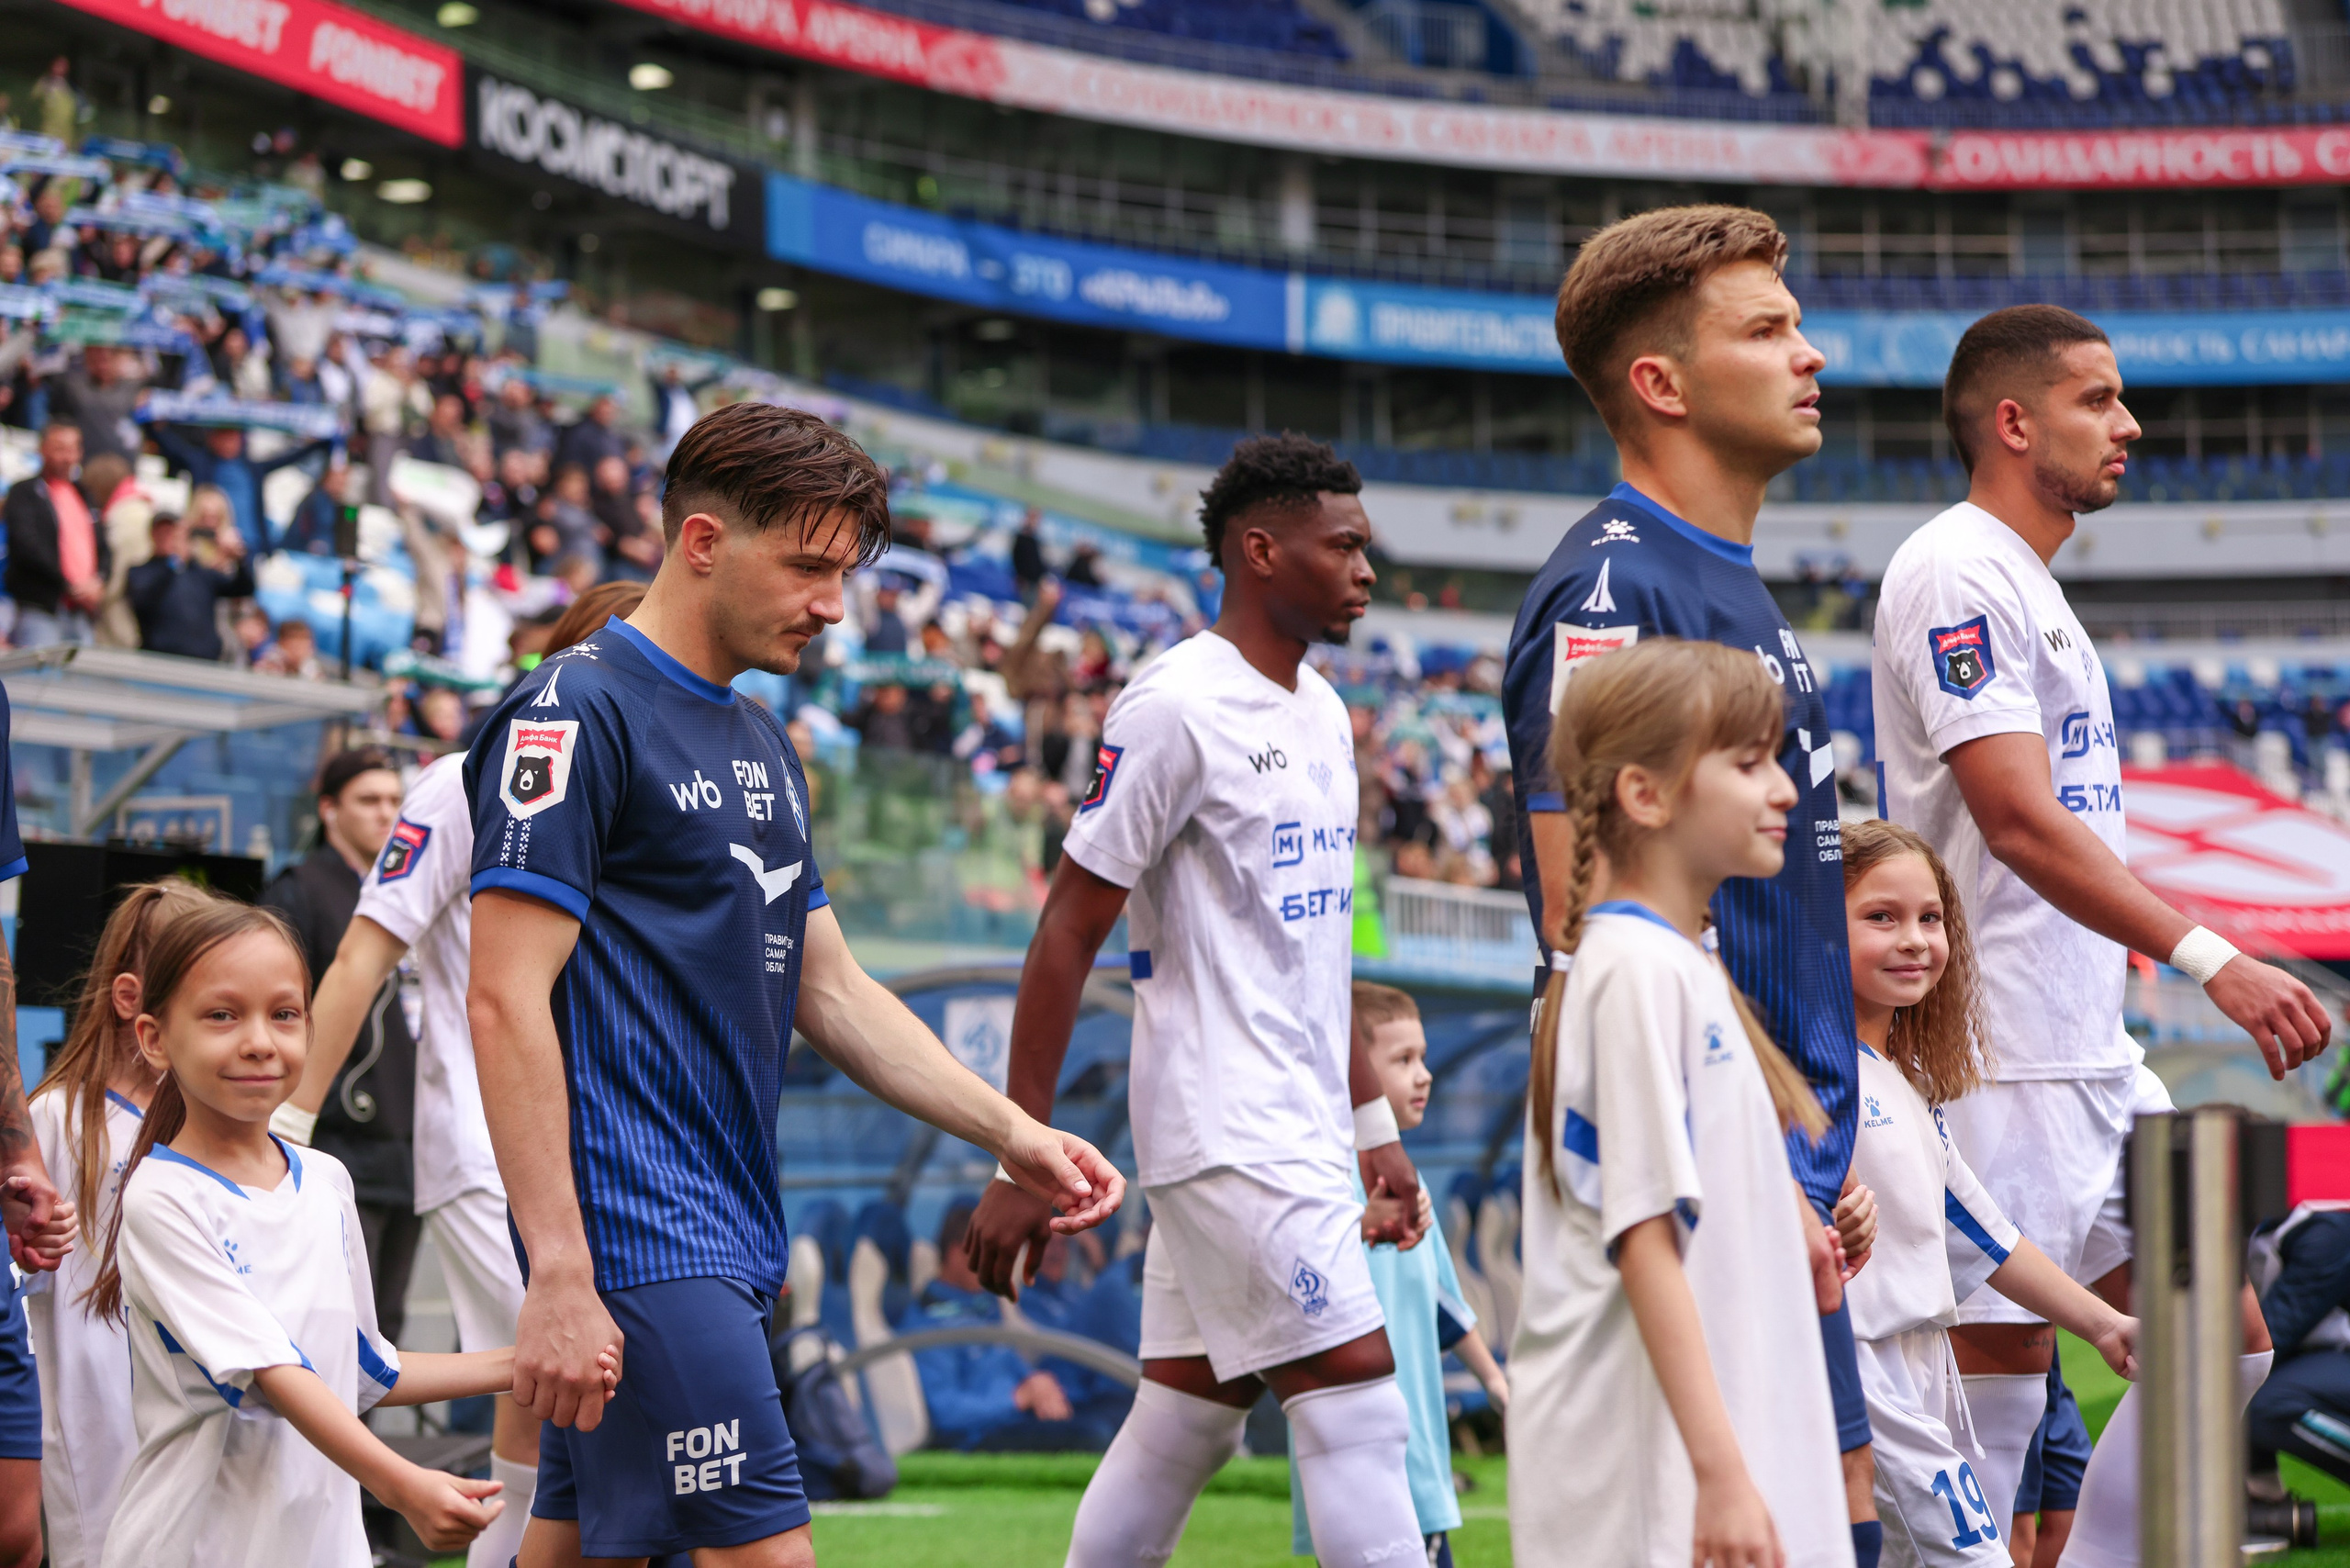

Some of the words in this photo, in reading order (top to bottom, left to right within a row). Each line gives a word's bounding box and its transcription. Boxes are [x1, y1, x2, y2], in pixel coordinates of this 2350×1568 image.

[140, 0, 291, 54] NBET
[732, 760, 769, 789] FON
[1248, 742, 1287, 774] wb
[669, 769, 722, 812] wb
[744, 790, 775, 821] BET
[1863, 1116, 1894, 1128] KELME
[666, 1418, 740, 1462] FON
[675, 1452, 747, 1495] BET
[1930, 1461, 1998, 1551] 19
